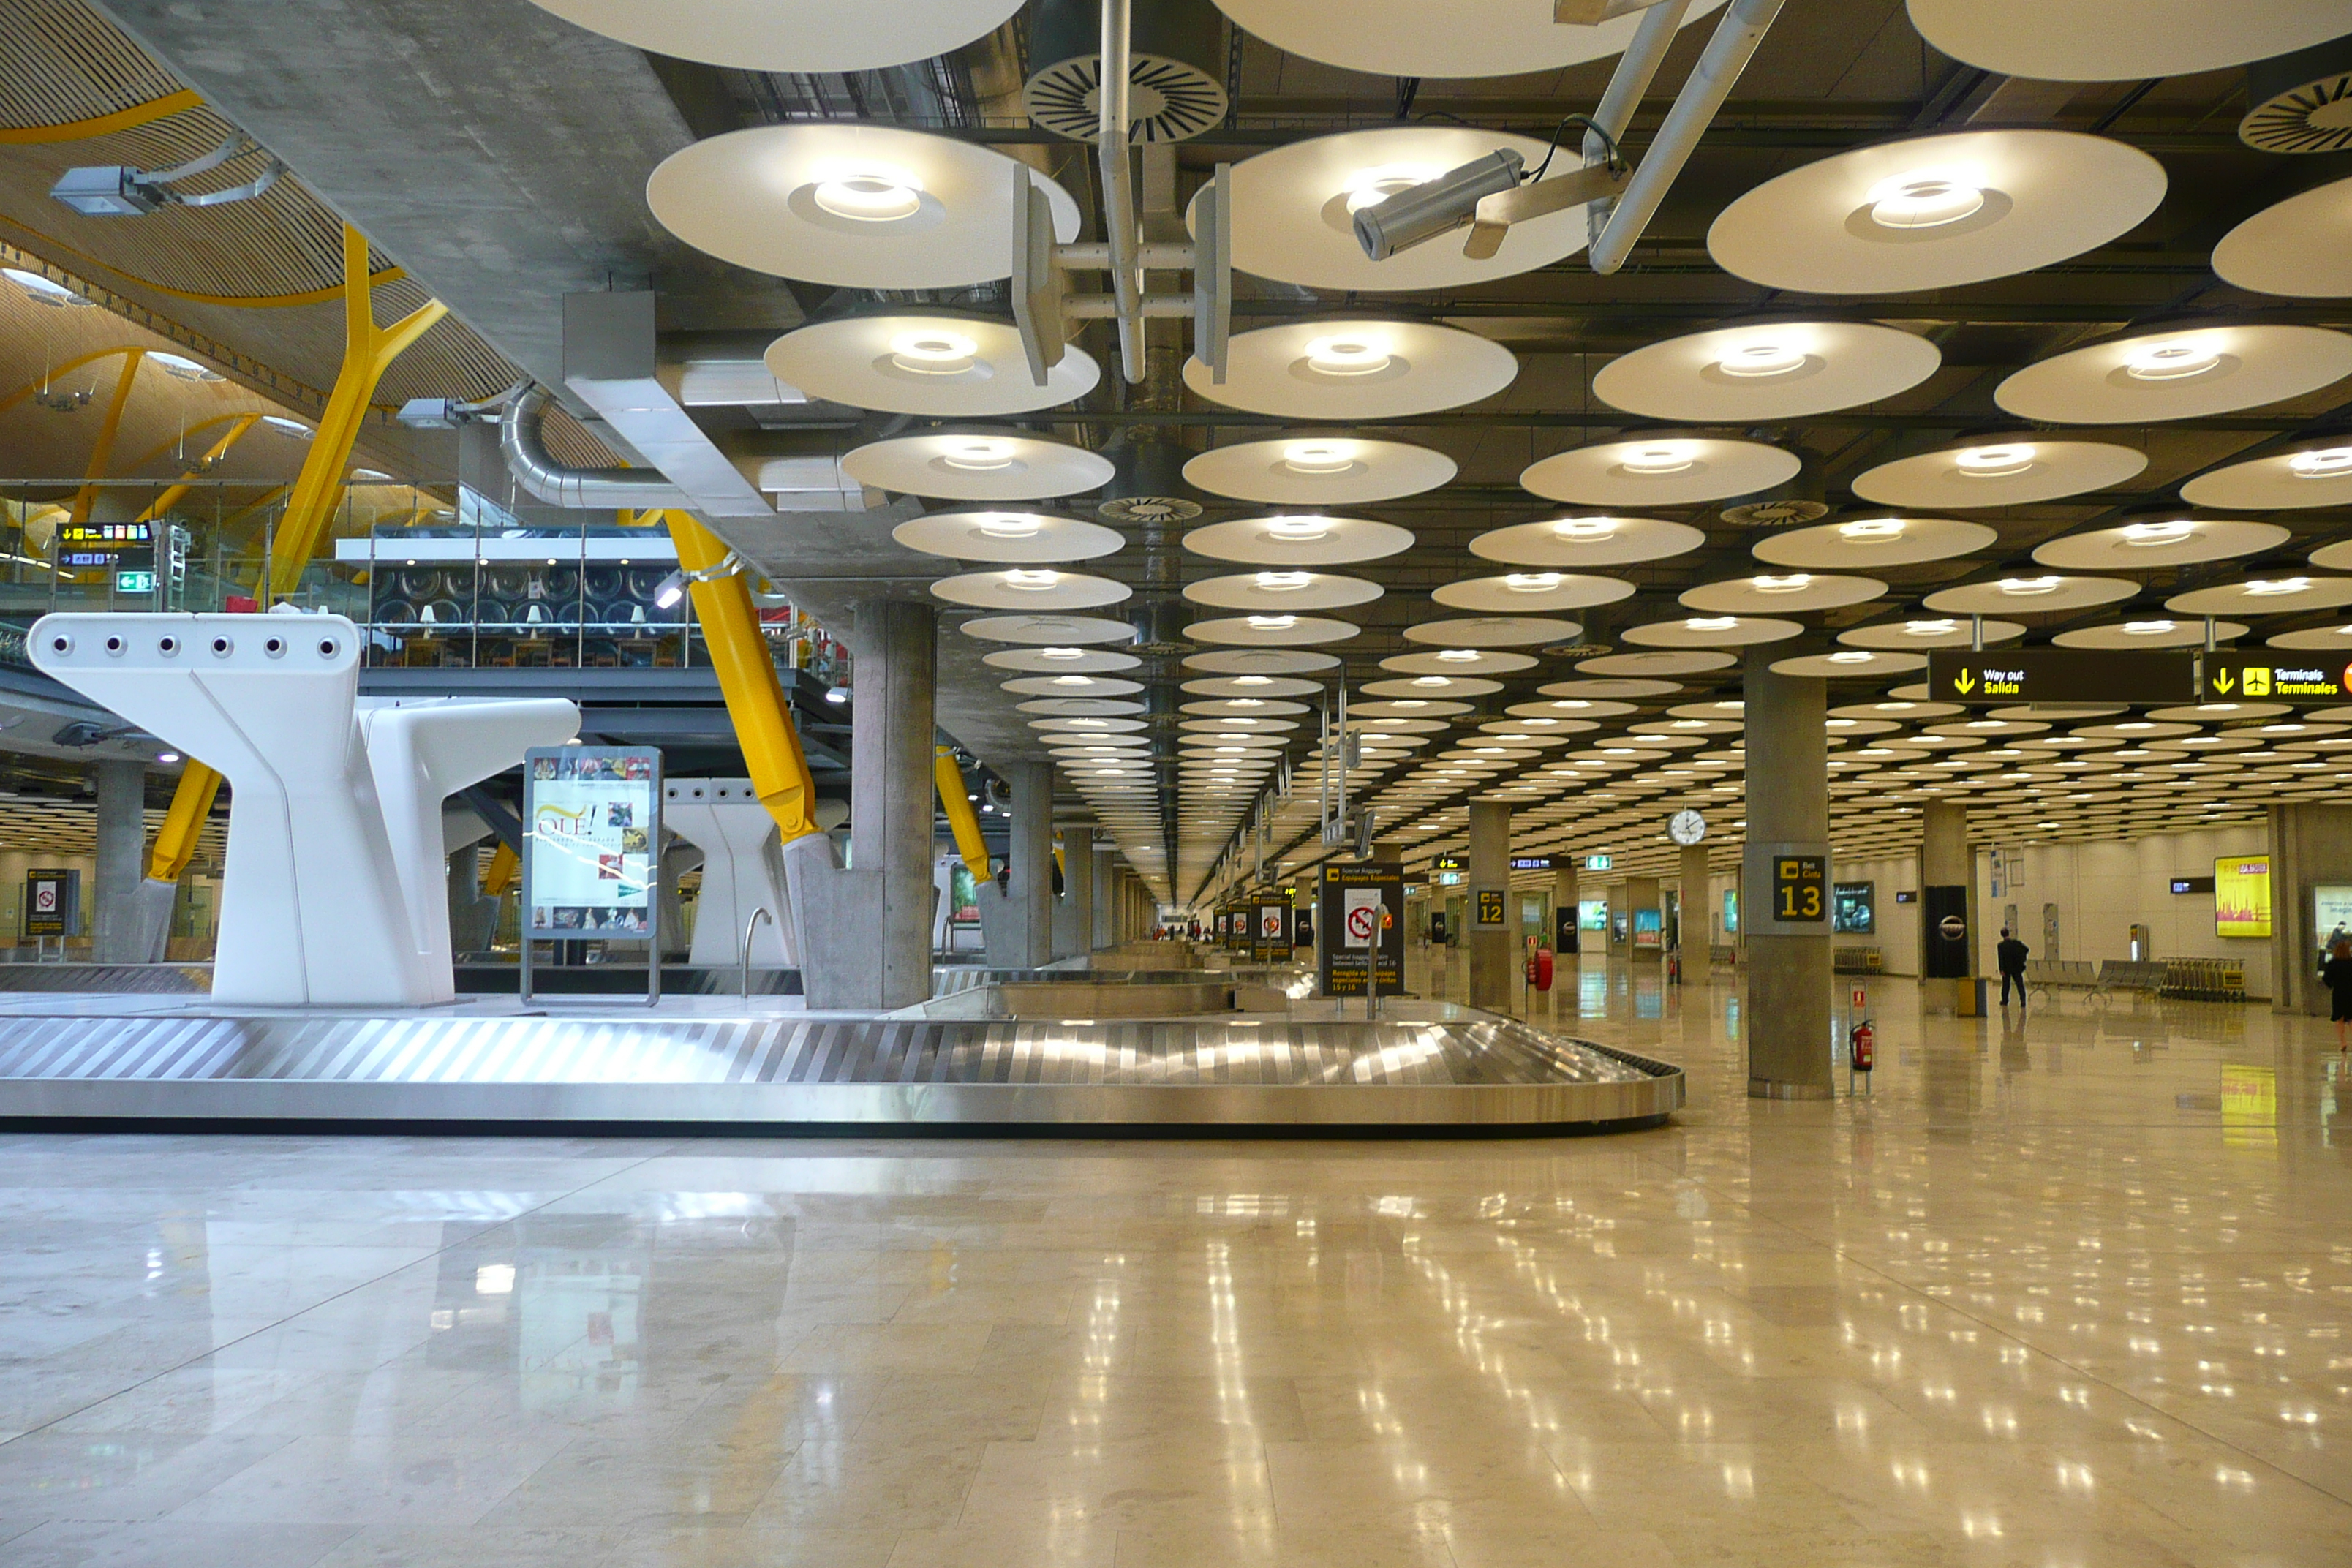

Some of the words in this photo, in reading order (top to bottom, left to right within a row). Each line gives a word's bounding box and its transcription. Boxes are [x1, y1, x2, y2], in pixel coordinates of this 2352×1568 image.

[1983, 669, 2005, 682] Way
[2007, 670, 2024, 682] out
[2274, 668, 2323, 681] Terminals
[1984, 682, 2019, 694] Salida
[2275, 682, 2338, 695] Terminales
[1371, 874, 1400, 882] Especiales
[1802, 870, 1821, 878] Cinta
[1781, 886, 1821, 917] 13
[1481, 905, 1501, 922] 12
[1333, 970, 1359, 978] Recogida
